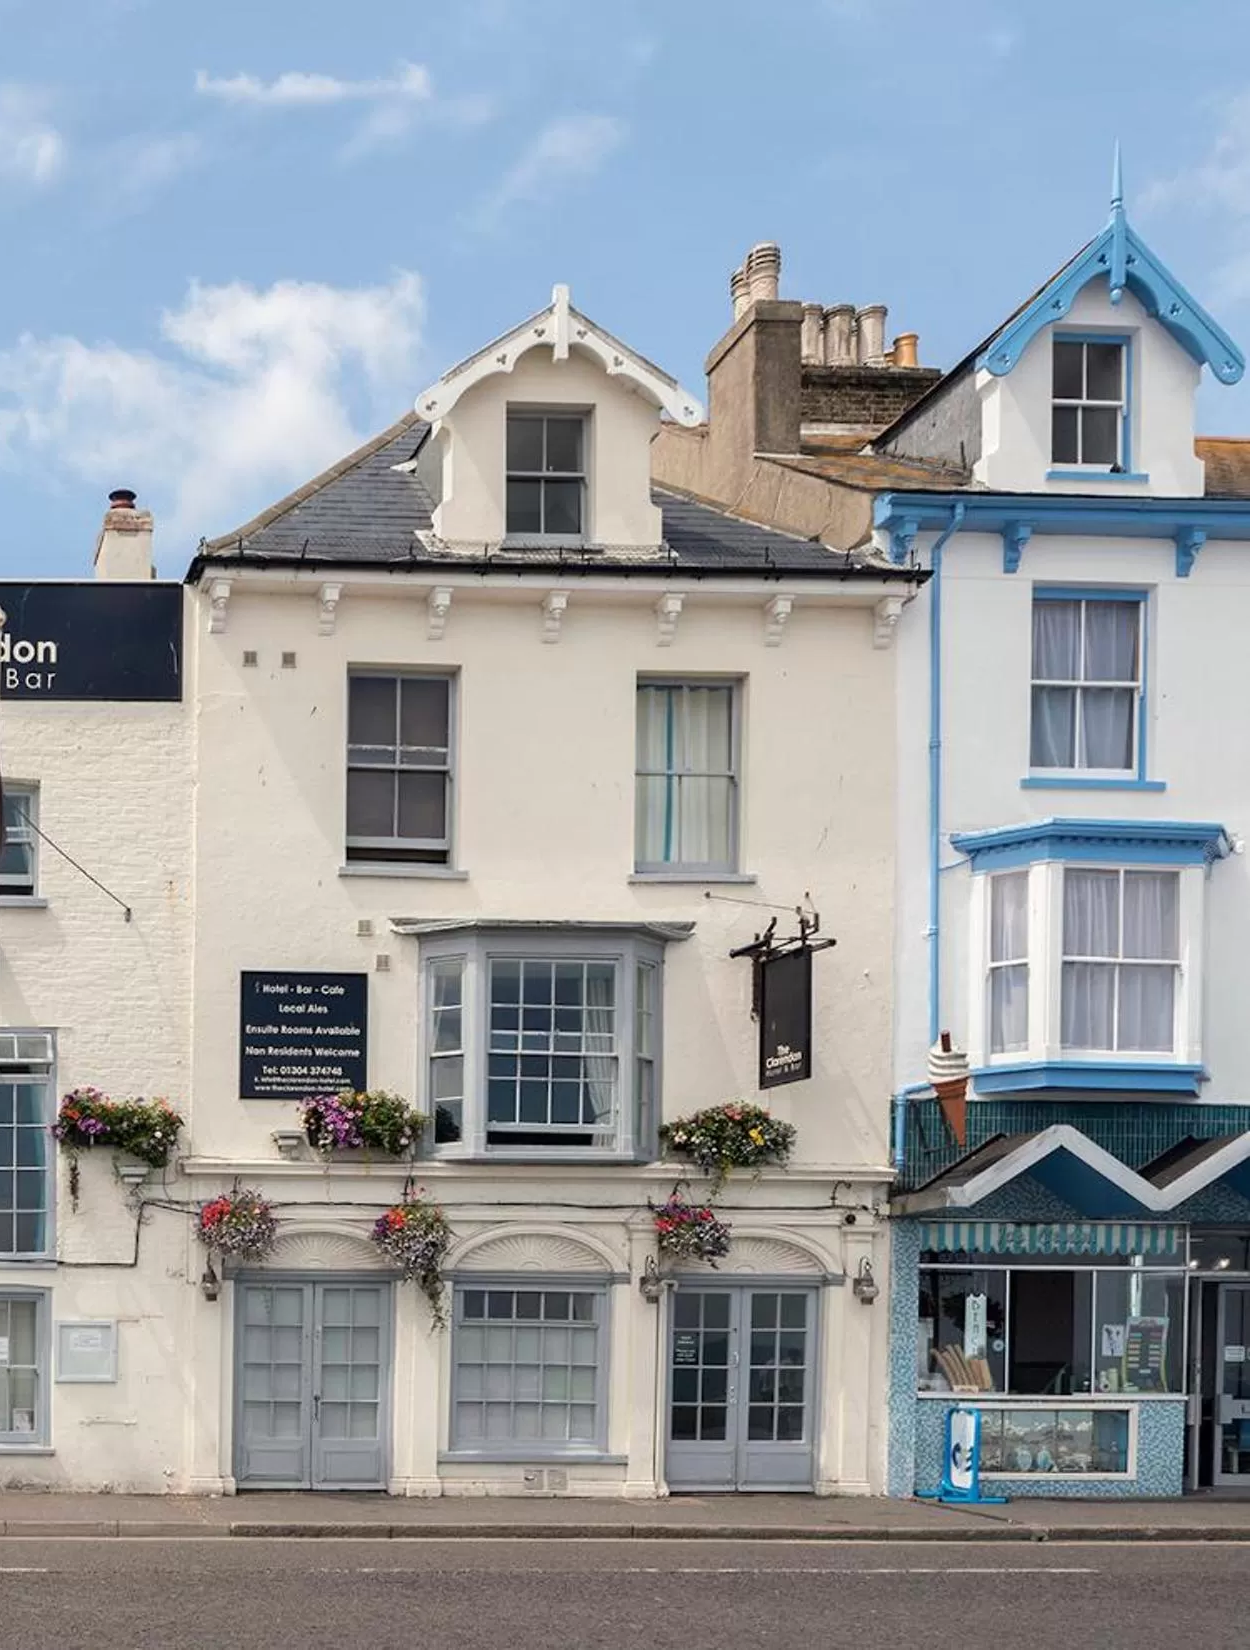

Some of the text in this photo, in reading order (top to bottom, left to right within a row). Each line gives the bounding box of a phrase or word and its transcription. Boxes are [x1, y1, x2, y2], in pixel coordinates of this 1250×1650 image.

[6, 668, 56, 689] Bar
[262, 984, 288, 994] Hotel
[296, 985, 312, 994] Bar
[279, 1004, 328, 1014] Local Ales
[246, 1025, 360, 1036] Ensuite Rooms Available
[245, 1046, 360, 1057] Non Residents Welcome
[279, 1066, 308, 1075] 01304
